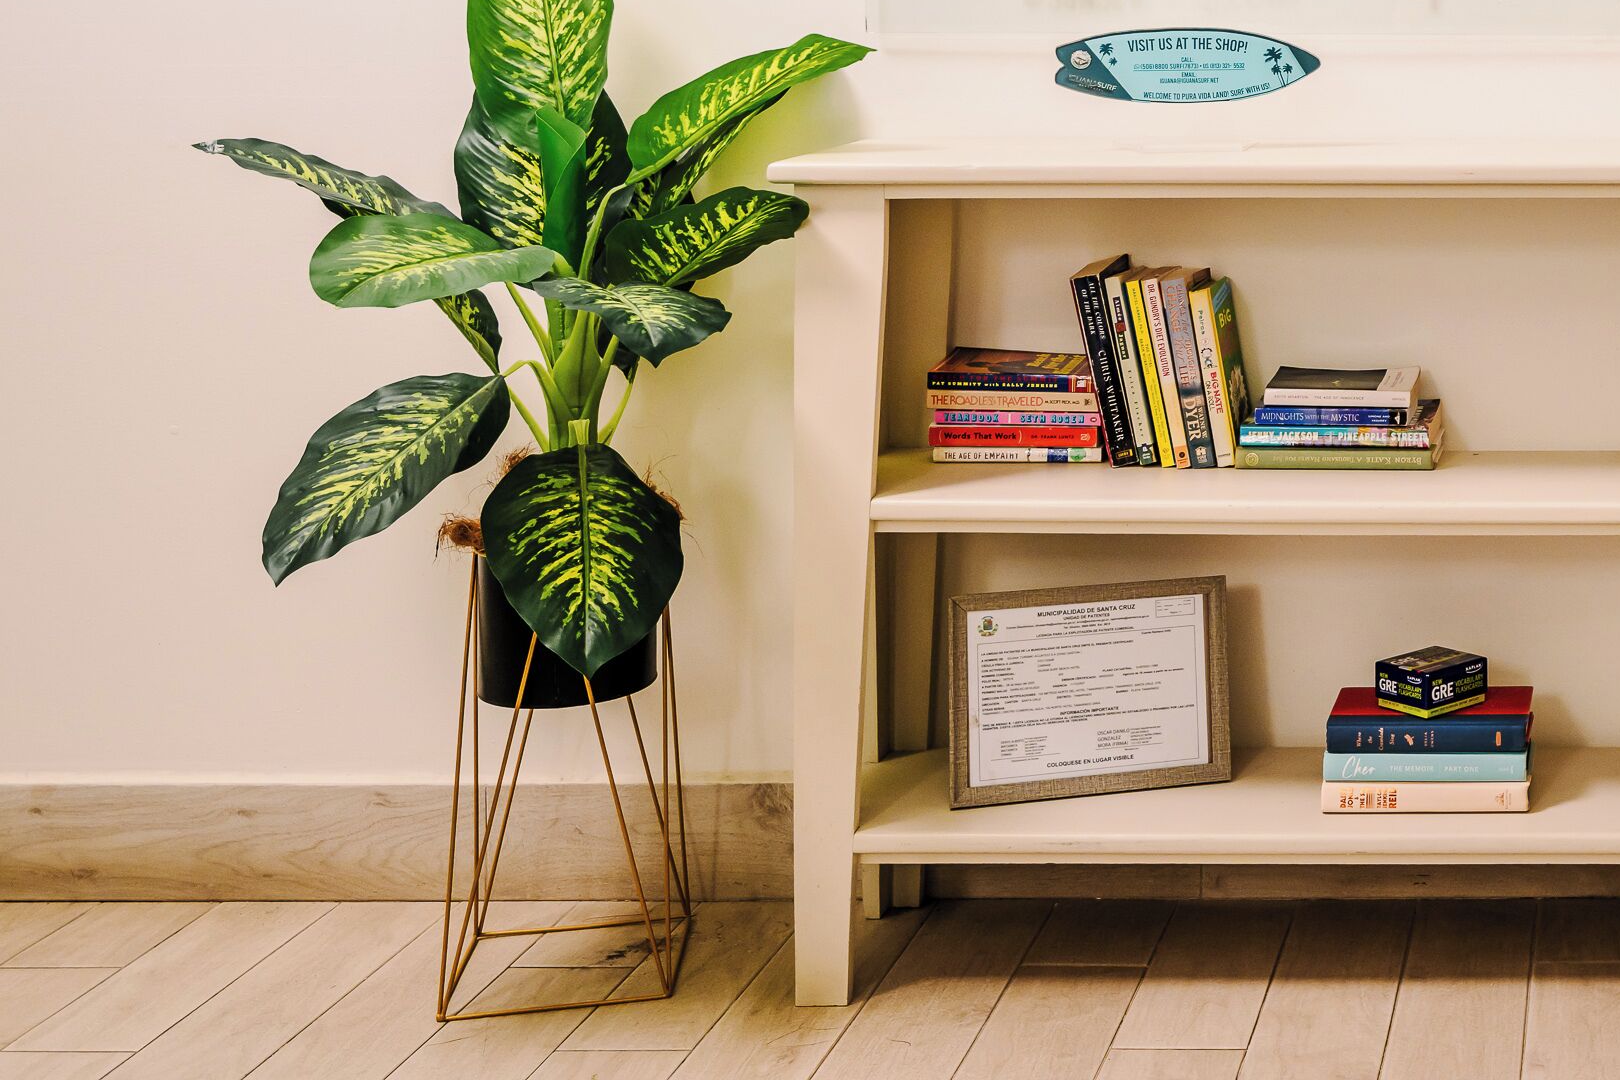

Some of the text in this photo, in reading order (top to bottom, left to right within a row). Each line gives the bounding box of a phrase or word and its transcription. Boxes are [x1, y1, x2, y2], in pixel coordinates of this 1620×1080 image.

[1128, 37, 1248, 53] VISIT US AT THE SHOP!
[1173, 92, 1180, 100] TO
[1181, 92, 1196, 100] PURA
[1197, 92, 1211, 100] VIDA
[1212, 90, 1229, 99] LAND!
[1230, 87, 1244, 97] SURF
[1244, 84, 1261, 94] WITH
[1147, 284, 1155, 296] DR.
[1149, 296, 1161, 327] GUNDRY'S
[1155, 327, 1164, 342] DIET
[1158, 342, 1171, 377] EVOLUTION
[931, 395, 949, 405] THE
[949, 395, 978, 405] ROAD
[997, 396, 1044, 407] TRAVELED
[1098, 349, 1124, 441] CHRIS WHITAKER
[1213, 391, 1224, 414] NATE
[943, 413, 1085, 423] YEARBOOK SETH ROGEN
[1184, 399, 1202, 441] DYER
[1261, 412, 1360, 422] MIDNIGHTS MYSTIC
[944, 432, 971, 440] Words
[1277, 431, 1319, 441] JACKSON
[1338, 432, 1426, 442] PINEAPPLE STREET
[984, 452, 1018, 460] EMPATHY
[1037, 608, 1085, 618] MUNICIPALIDAD
[1096, 605, 1117, 613] SANTA
[1379, 678, 1398, 693] GRE
[1431, 682, 1454, 700] GRE
[1046, 759, 1082, 768] COLOQUESE
[1342, 755, 1376, 779] Cher
